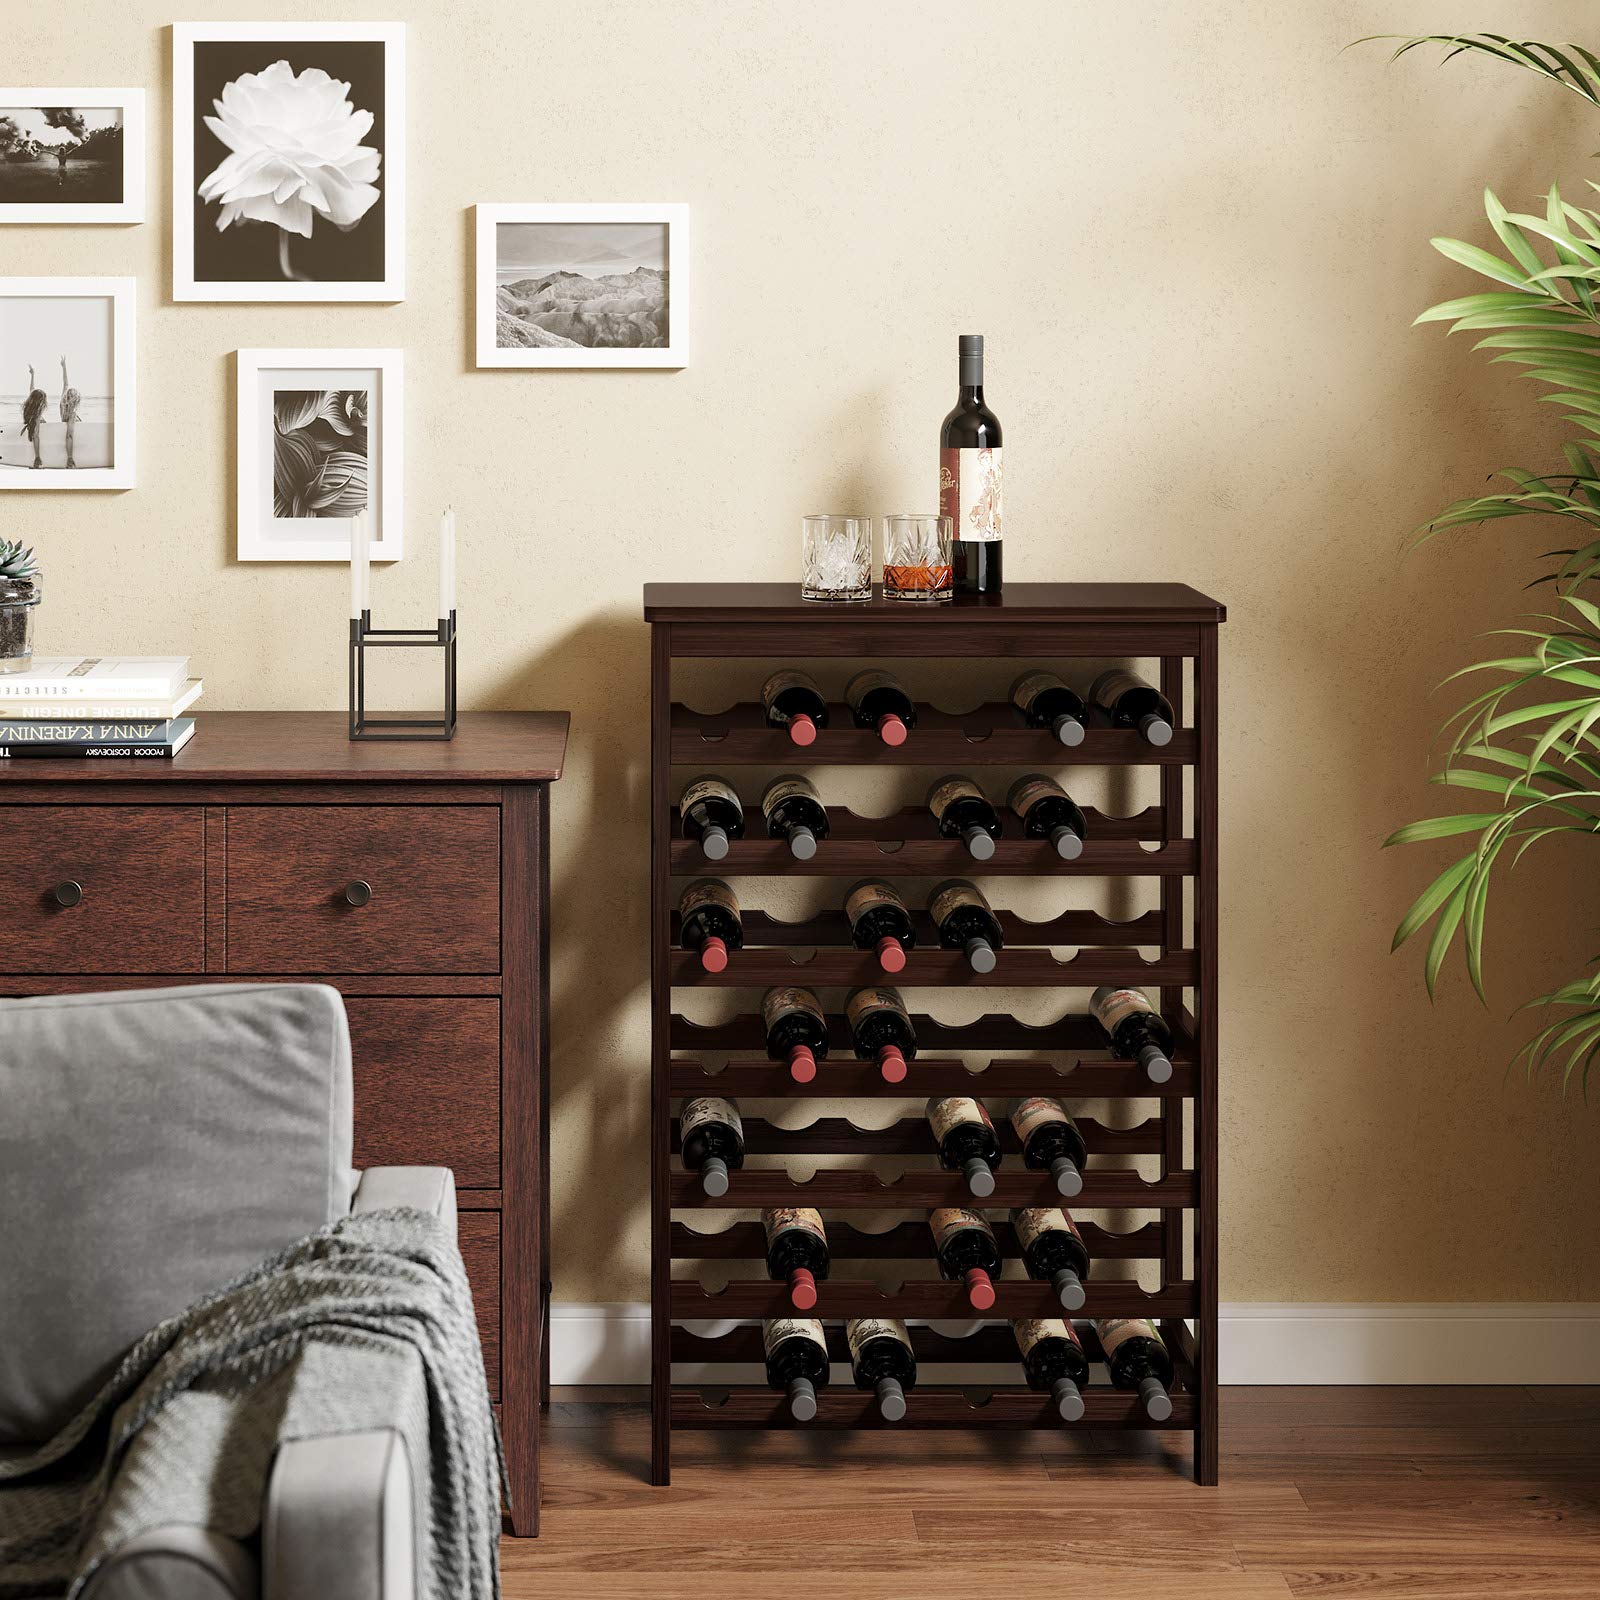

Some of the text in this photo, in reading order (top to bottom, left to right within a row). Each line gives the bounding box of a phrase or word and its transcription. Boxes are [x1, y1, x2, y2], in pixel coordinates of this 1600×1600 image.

[0, 686, 68, 695] SELECTE
[22, 707, 160, 718] EUGENE ONEGIN
[99, 724, 157, 740] ANNA
[85, 748, 165, 756] FYODOR DOSTOEVSKY
